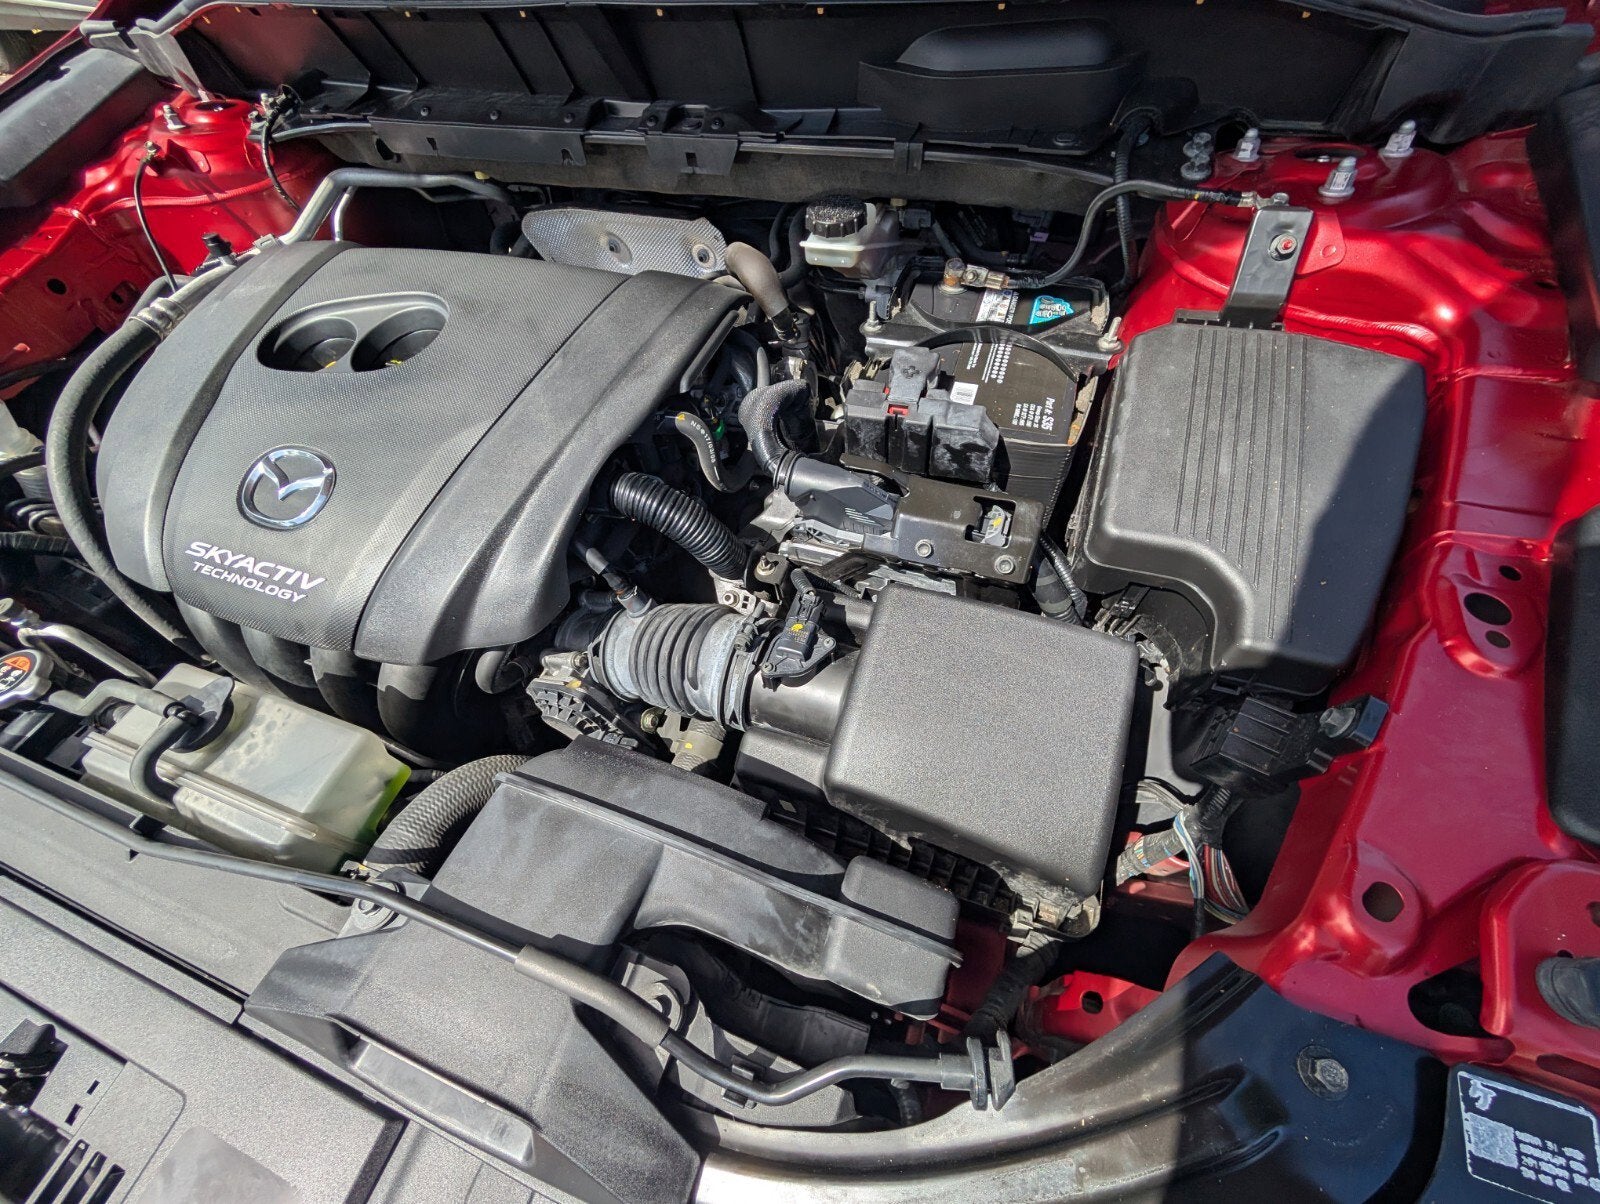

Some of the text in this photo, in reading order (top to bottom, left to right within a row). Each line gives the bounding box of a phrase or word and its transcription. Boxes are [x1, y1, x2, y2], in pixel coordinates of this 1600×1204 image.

[1041, 415, 1055, 431] S35
[184, 541, 327, 590] SKYACTIV
[192, 561, 308, 603] TECHNOLOGY
